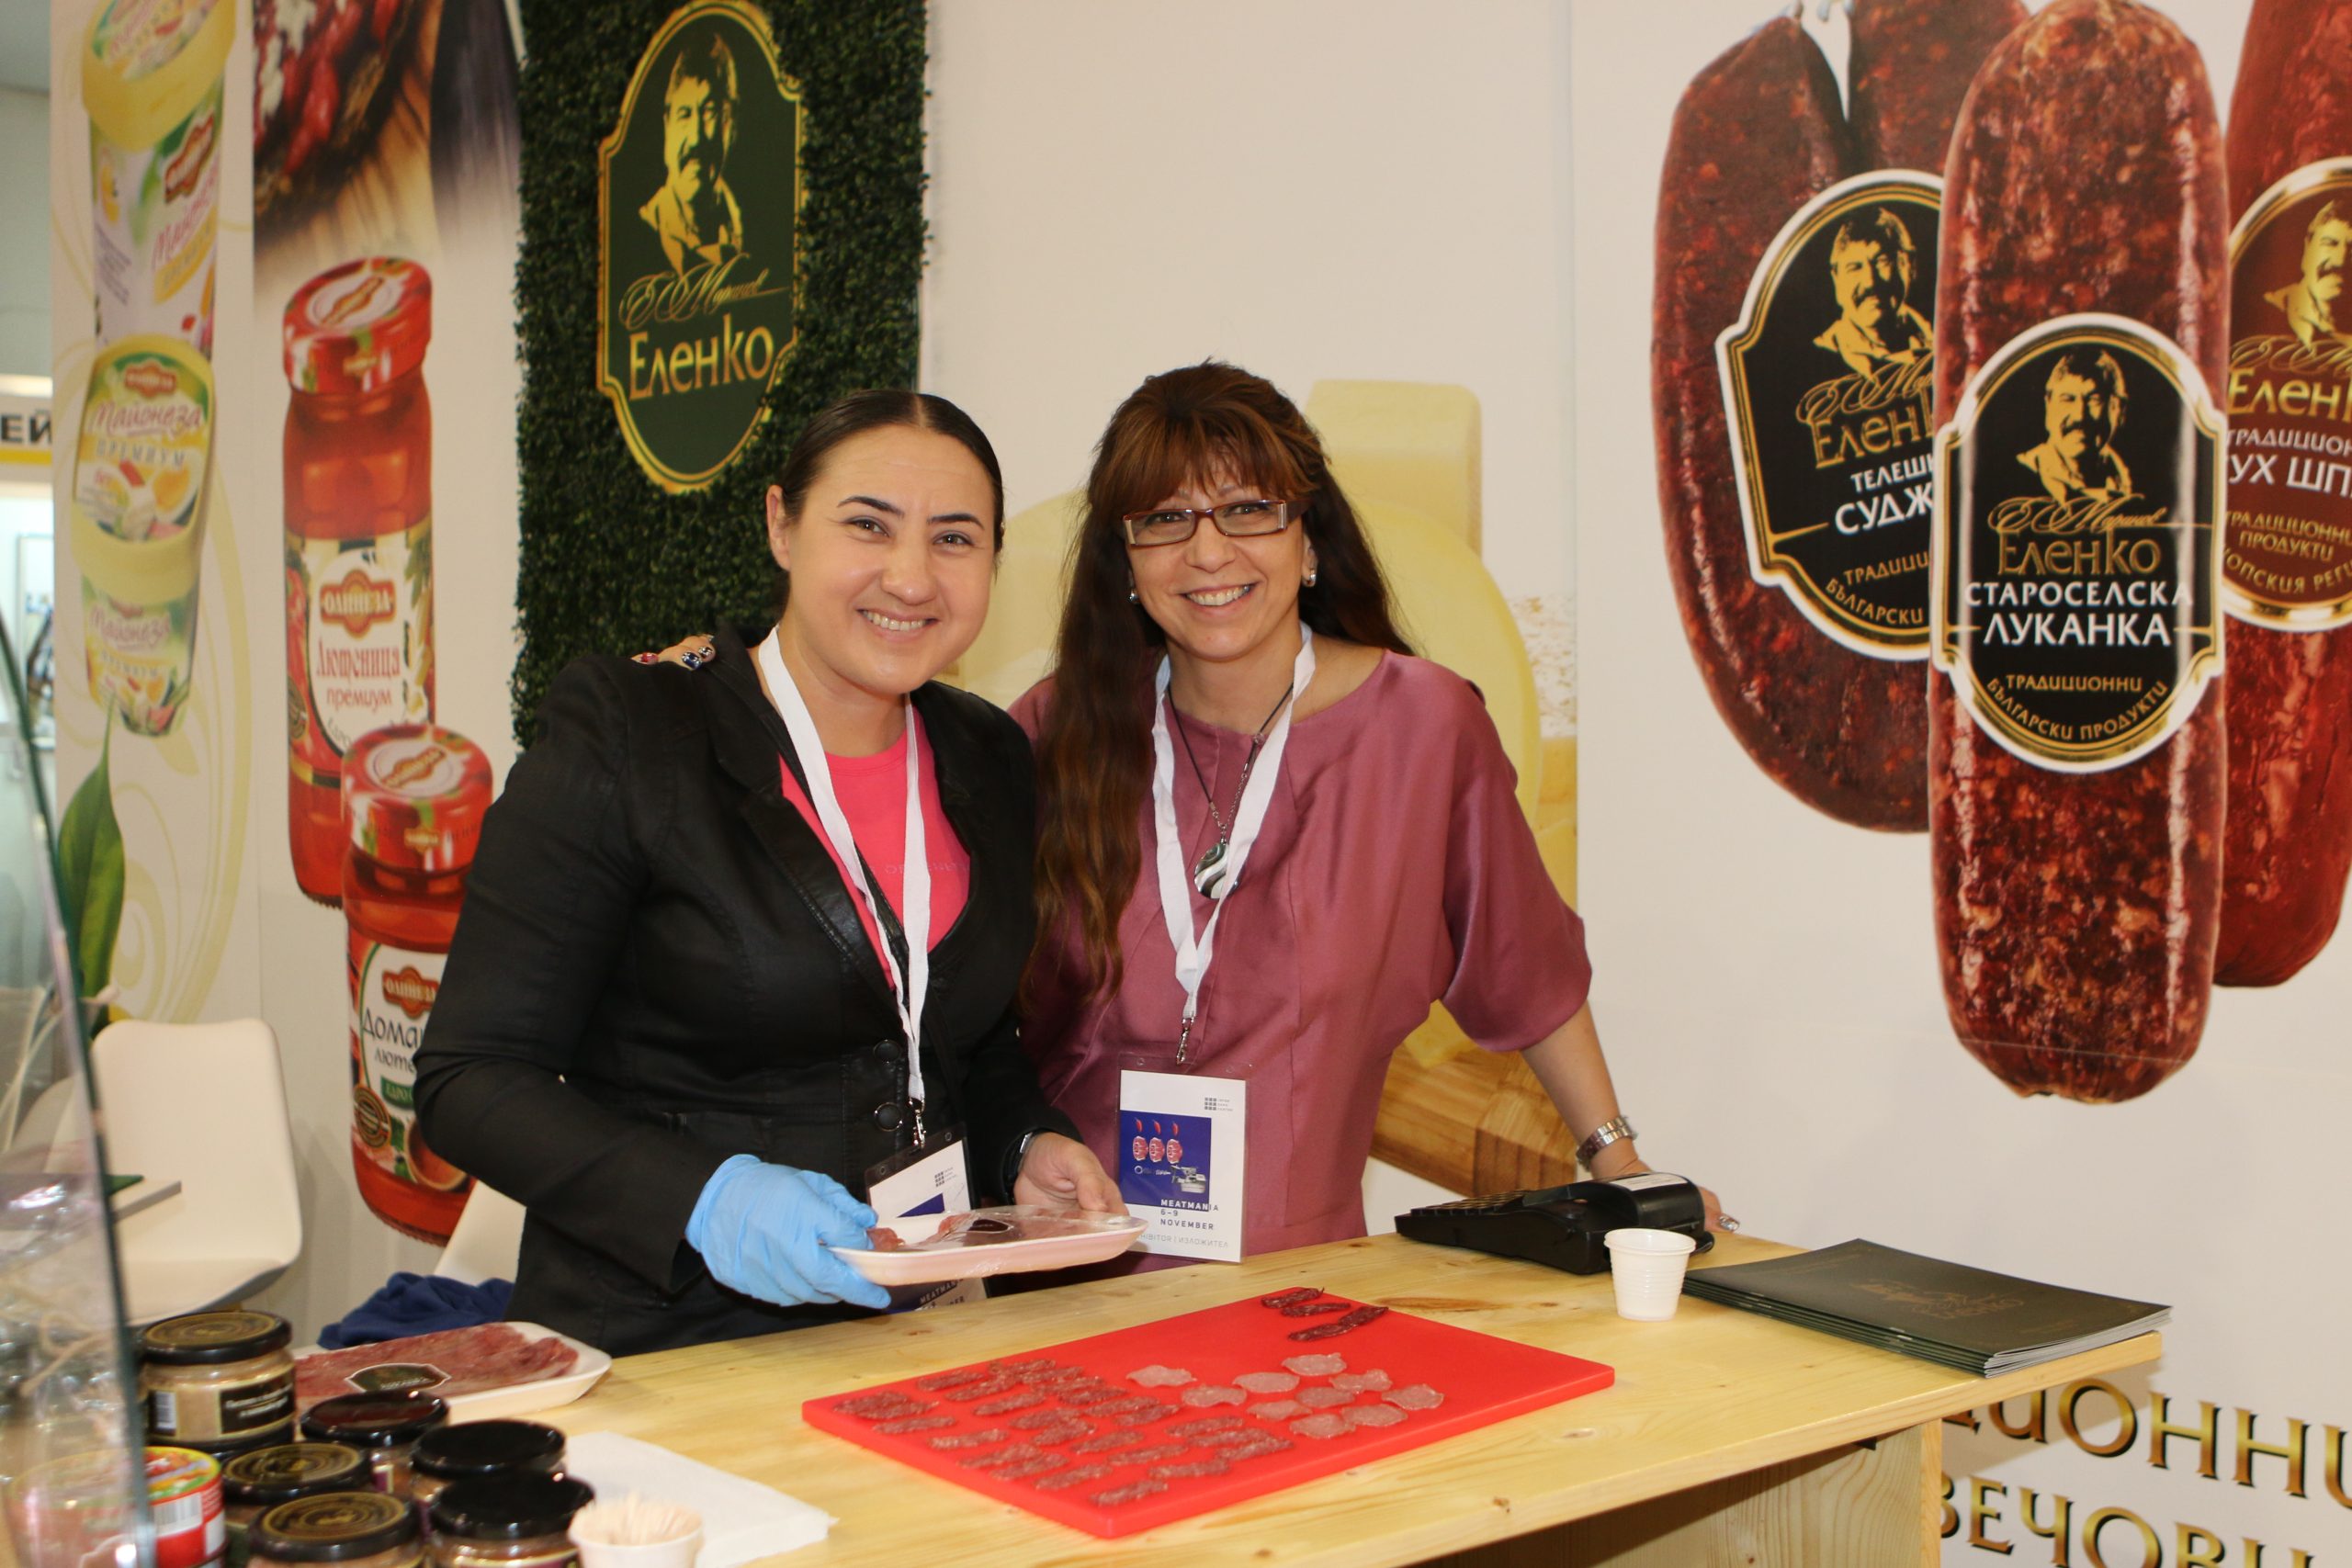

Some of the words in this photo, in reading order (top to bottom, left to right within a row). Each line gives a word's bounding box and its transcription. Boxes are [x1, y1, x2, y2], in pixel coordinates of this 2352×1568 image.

[2286, 456, 2352, 501] ШП
[2239, 529, 2335, 562] ПРОДУКТИ
[1825, 578, 1924, 625] БЪЛГАРСКИ
[1963, 581, 2194, 608] СТАРОСЕЛСКА
[1983, 612, 2172, 647] ЛУКАНКА
[2007, 674, 2143, 694] ТРАДИЦИОННИ
[1987, 678, 2073, 740] БЪЛГАРСКИ
[2080, 681, 2169, 740] ПРОДУКТИ
[363, 1007, 424, 1049] Дома
[1160, 1199, 1218, 1212] MEATMANIA
[1160, 1219, 1213, 1231] NOVEMBER
[920, 1280, 957, 1304] MEATMAN
[1941, 1378, 2352, 1511] ИОНН
